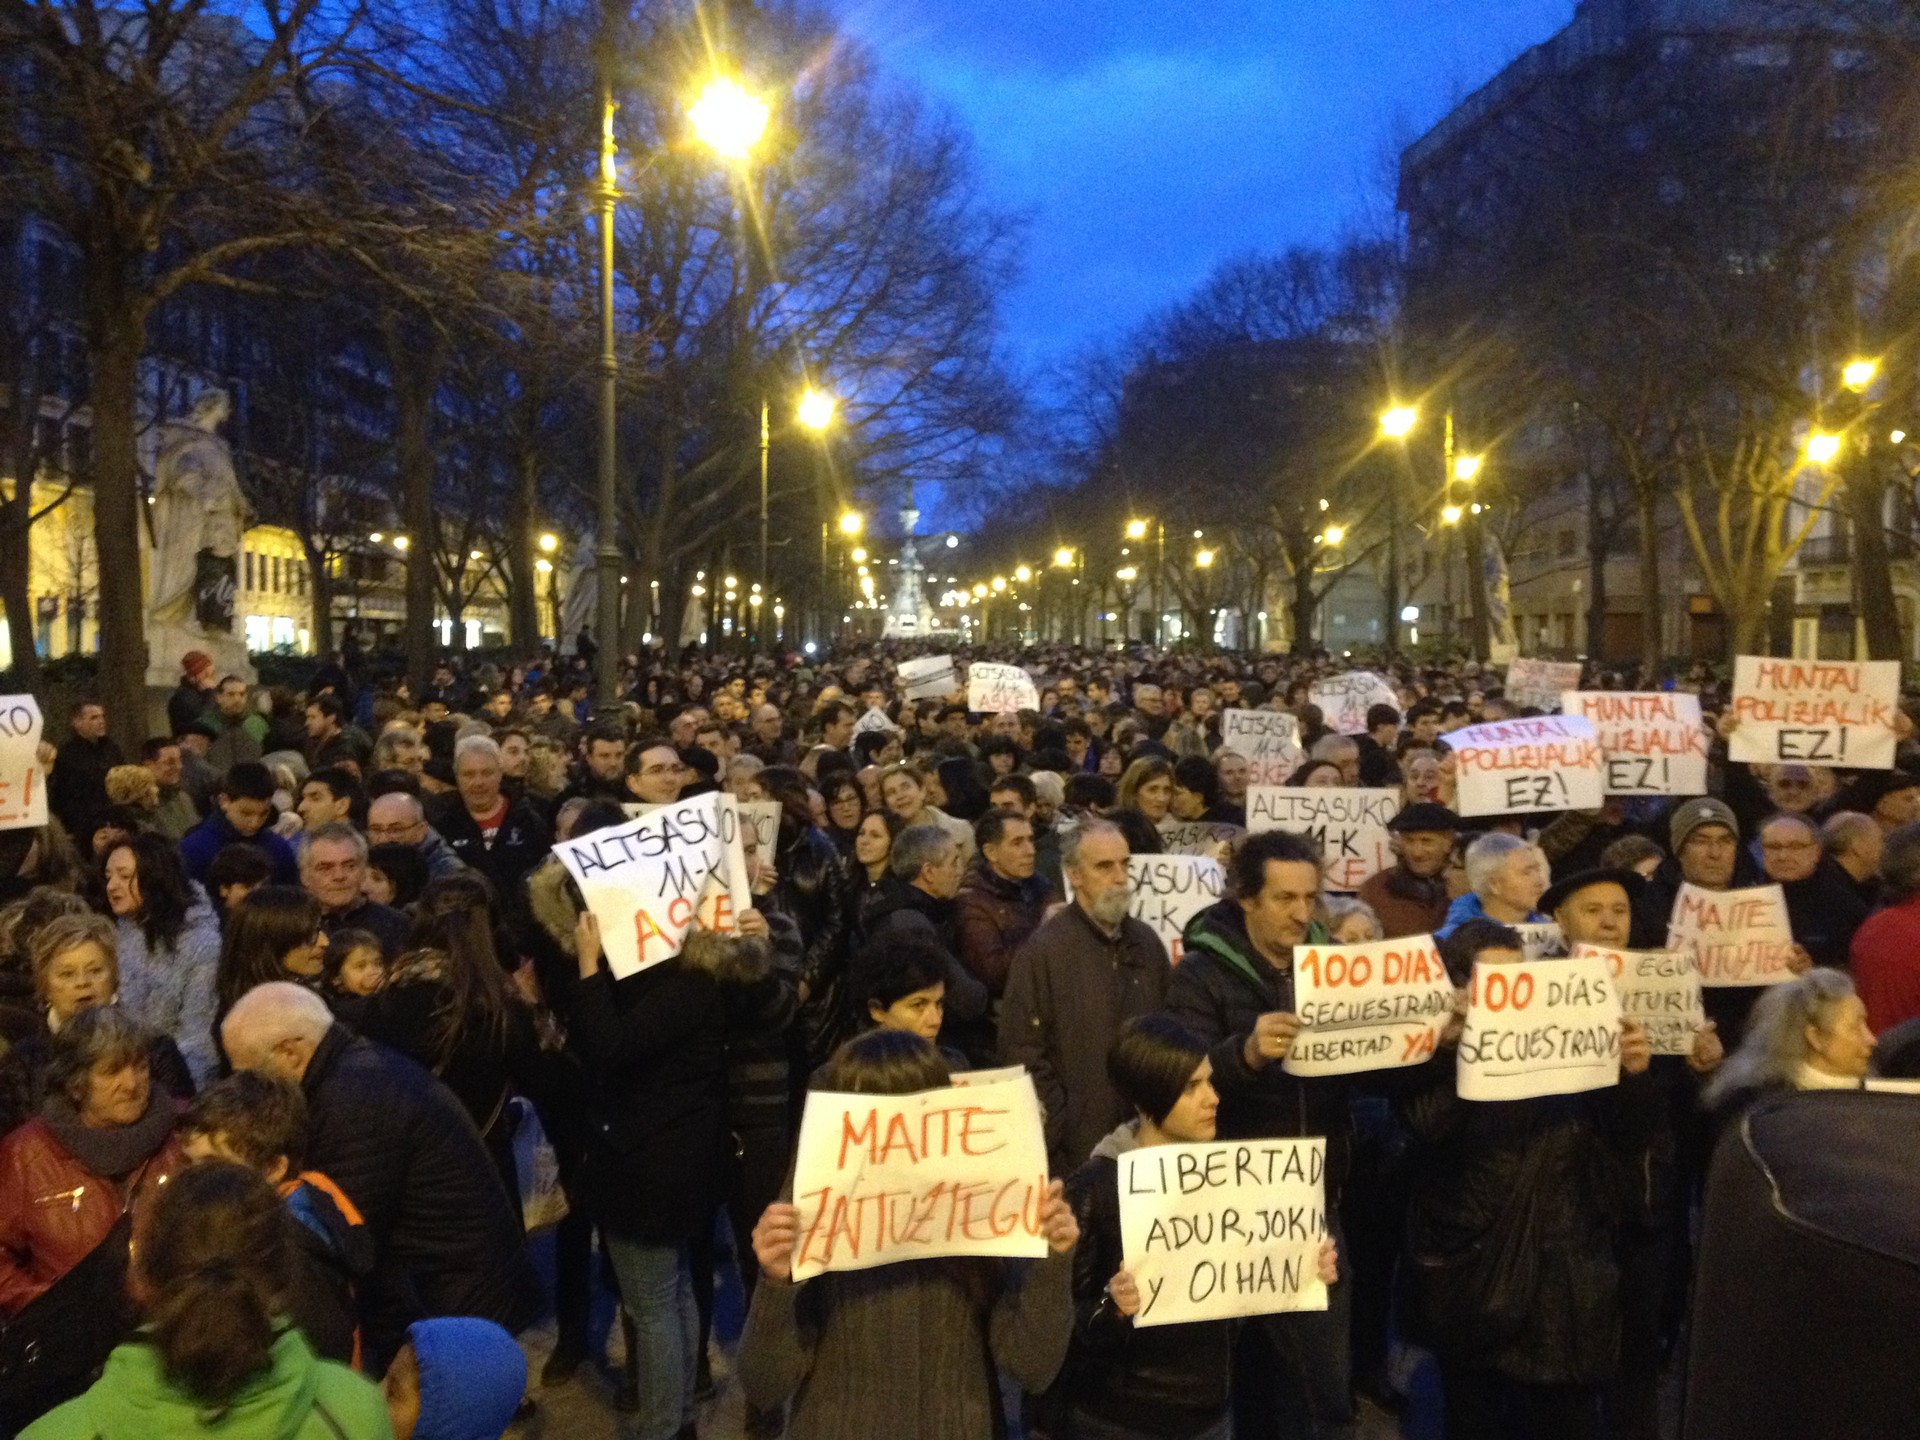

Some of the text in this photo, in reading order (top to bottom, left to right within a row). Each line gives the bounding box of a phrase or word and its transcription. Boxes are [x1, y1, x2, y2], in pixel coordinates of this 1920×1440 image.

[1598, 727, 1704, 756] LIZIALIK
[1778, 726, 1847, 762] EZ!
[1505, 771, 1571, 808] EZ!
[1608, 757, 1670, 793] EZ!
[1251, 793, 1397, 828] ALTSASUKO
[1299, 947, 1446, 989] 100 DIAS
[1290, 1027, 1436, 1063] LIBERTAD YA
[836, 1106, 1011, 1171] MAITE
[1129, 1144, 1325, 1196] LIBERTAD
[1189, 1255, 1303, 1304] OIHAN
